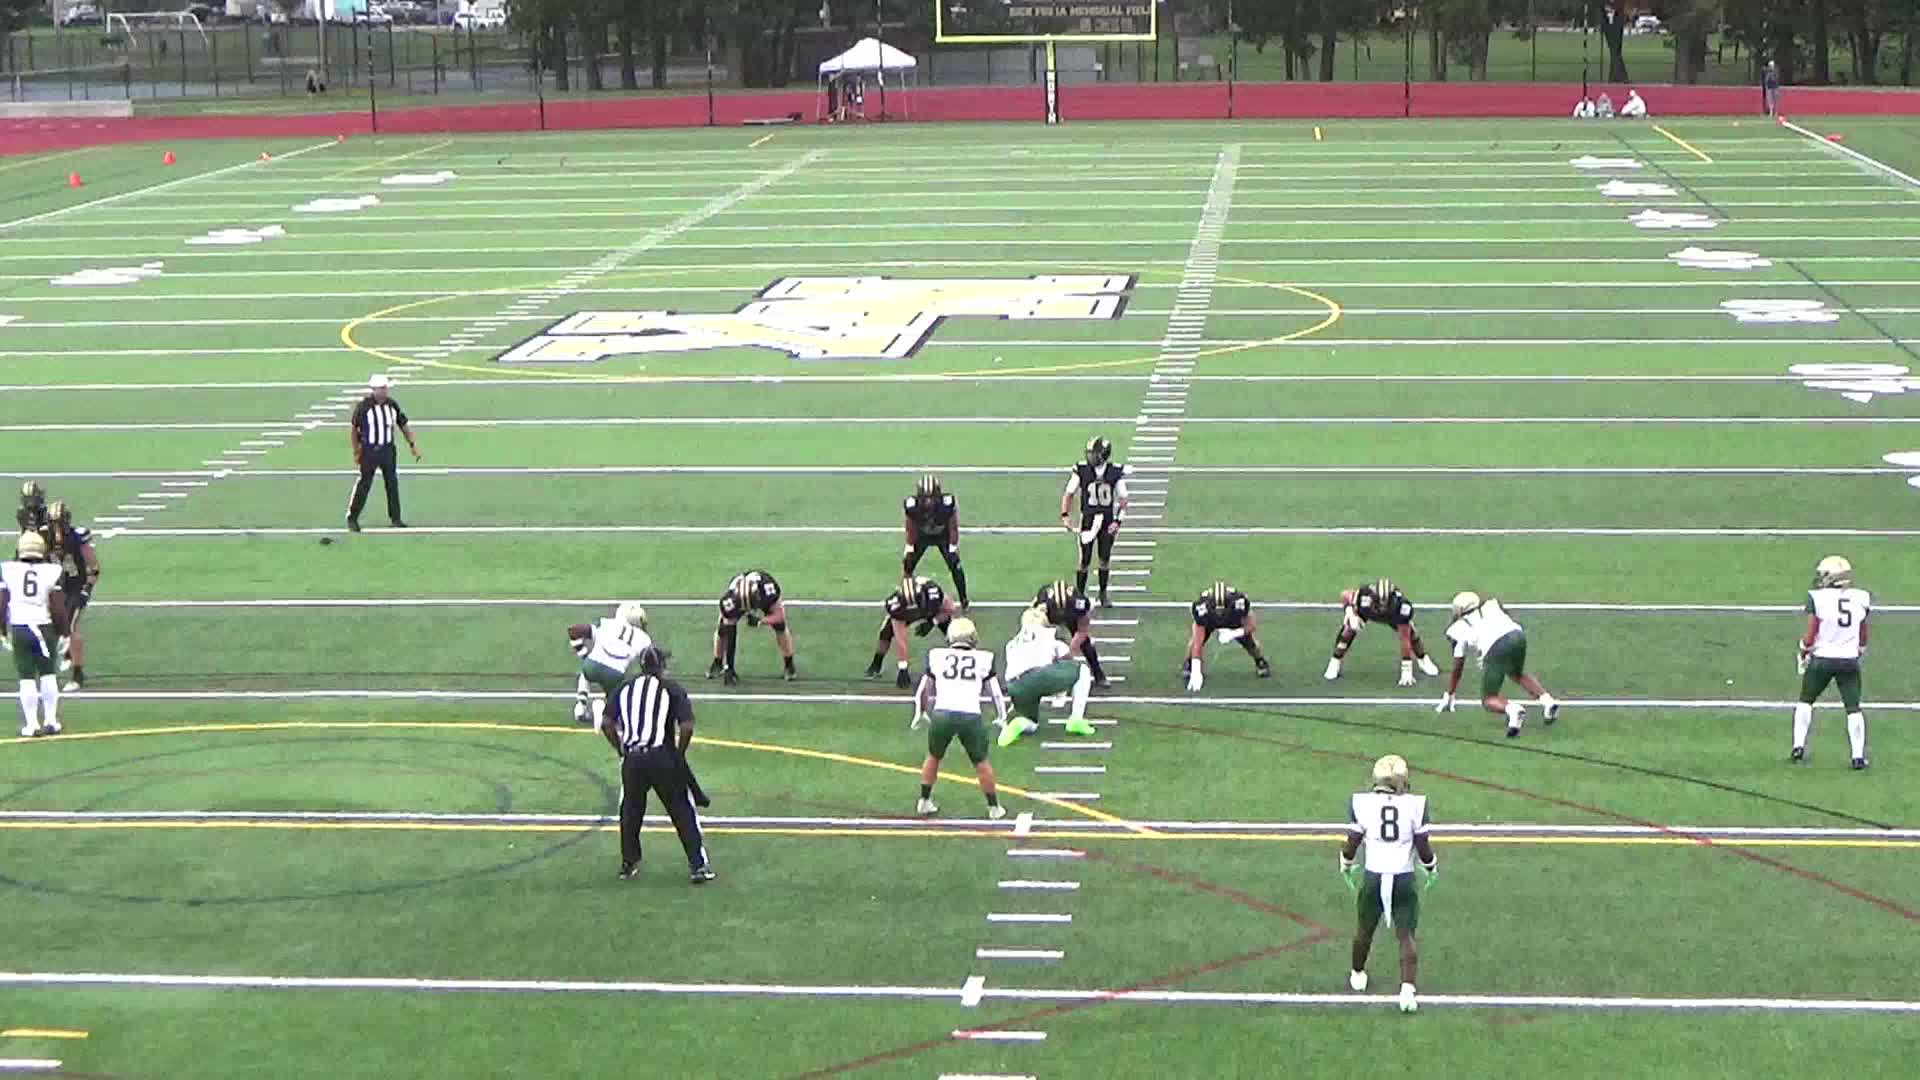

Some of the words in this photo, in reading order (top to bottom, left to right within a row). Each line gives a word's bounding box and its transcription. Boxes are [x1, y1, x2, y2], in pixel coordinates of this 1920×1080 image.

[1087, 481, 1112, 506] 10
[23, 570, 38, 597] 6
[1837, 598, 1852, 628] 5
[618, 625, 634, 648] 11
[943, 654, 976, 680] 32
[1380, 805, 1399, 842] 8
